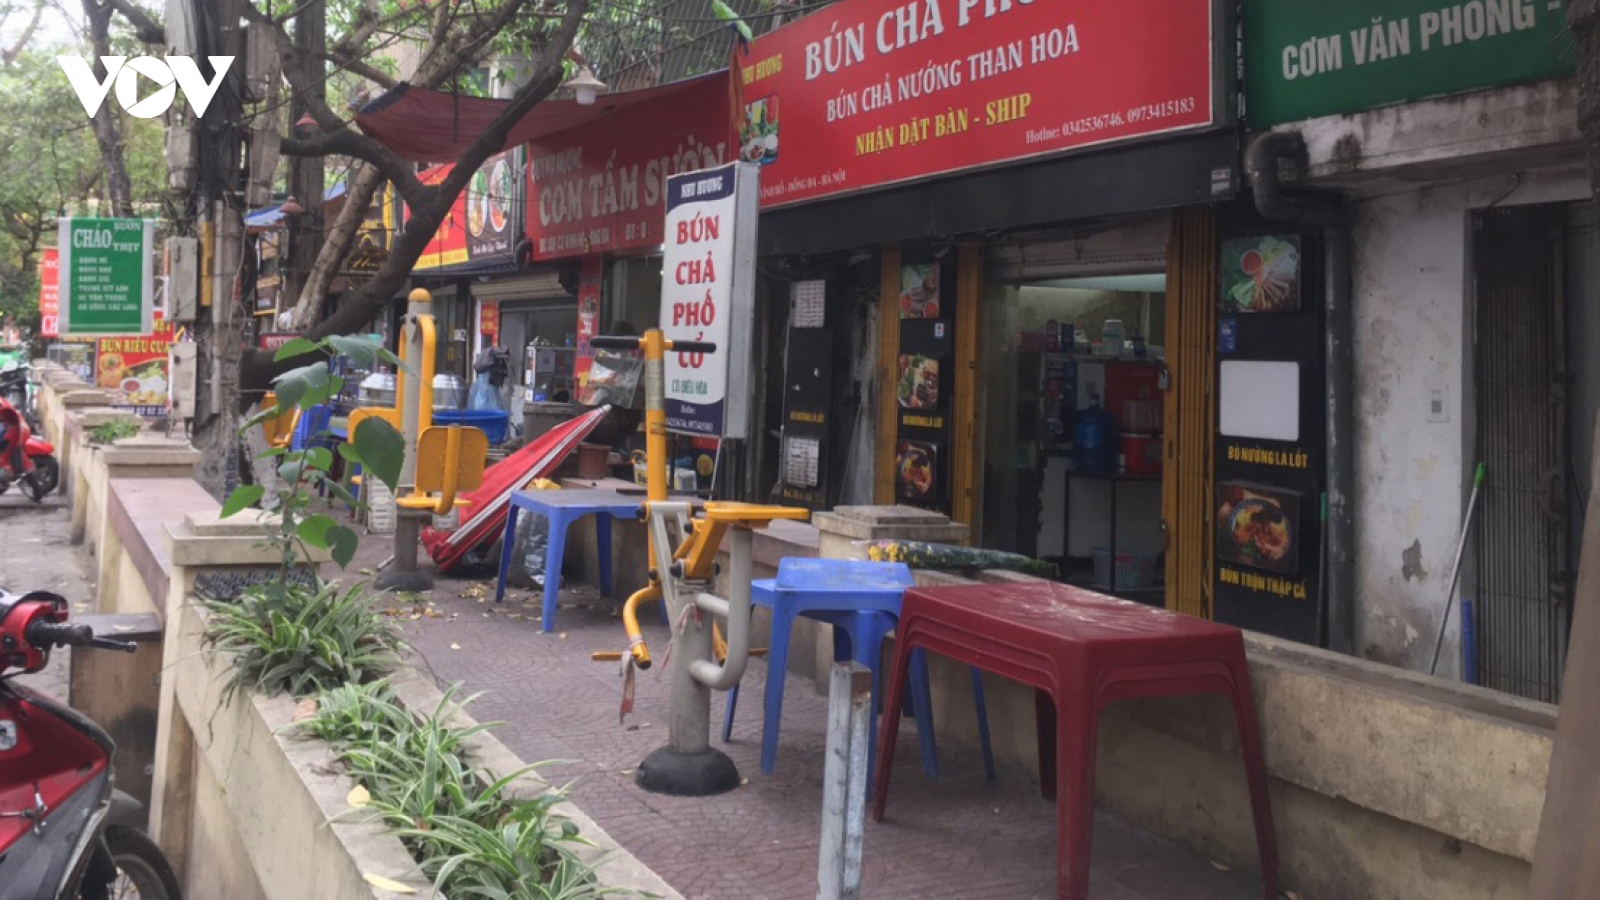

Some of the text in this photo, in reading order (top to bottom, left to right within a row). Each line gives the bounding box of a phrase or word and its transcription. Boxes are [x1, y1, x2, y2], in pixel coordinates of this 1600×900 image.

[805, 21, 865, 81] BÚN
[1282, 35, 1342, 81] CƠM
[1351, 15, 1410, 65] VĂN
[827, 24, 1080, 123] BÚN CHẢ NƯỚNG THAN HOA
[855, 126, 894, 156] NHẬN
[899, 117, 930, 146] ĐẶT
[935, 107, 968, 137] BÀN
[986, 92, 1032, 126] SHIP
[1127, 97, 1195, 124] 0973415183
[589, 148, 639, 217] TẤM
[73, 223, 112, 249] CHÁO
[676, 212, 720, 245] BÚN
[675, 251, 716, 285] CHẢ
[672, 289, 715, 326] PHỐ
[1228, 443, 1309, 469] BÒ NƯỚNG LÁ LỐT
